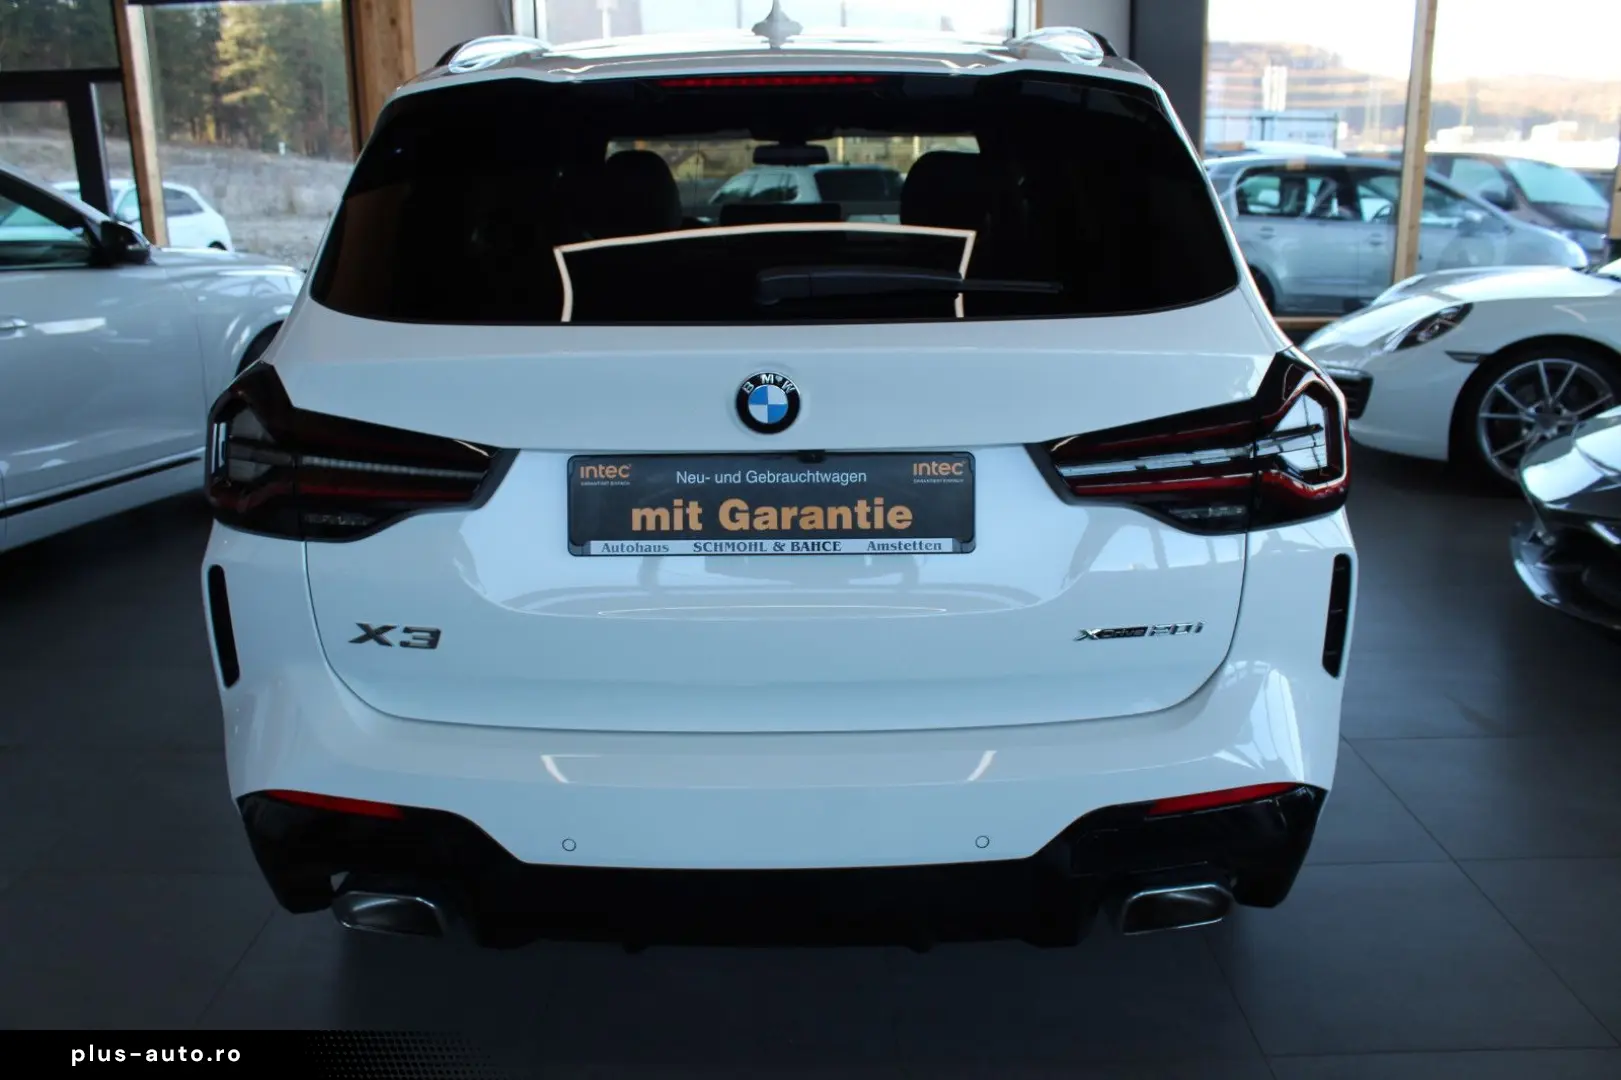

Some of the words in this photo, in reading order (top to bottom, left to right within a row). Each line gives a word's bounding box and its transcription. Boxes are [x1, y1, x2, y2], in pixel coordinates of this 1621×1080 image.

[742, 373, 795, 394] BMW
[580, 464, 630, 479] intec
[913, 460, 964, 476] intec
[676, 470, 710, 484] Neu-
[715, 471, 741, 484] und
[746, 470, 867, 486] Gebrauchtwagen
[631, 499, 703, 531] mit
[718, 497, 913, 531] Garantie
[601, 543, 670, 553] Autohaus
[693, 541, 767, 553] SCHMOHL
[773, 541, 786, 552] &
[791, 541, 842, 552] BAHCE
[867, 540, 942, 552] Amstetten
[348, 622, 441, 649] X3
